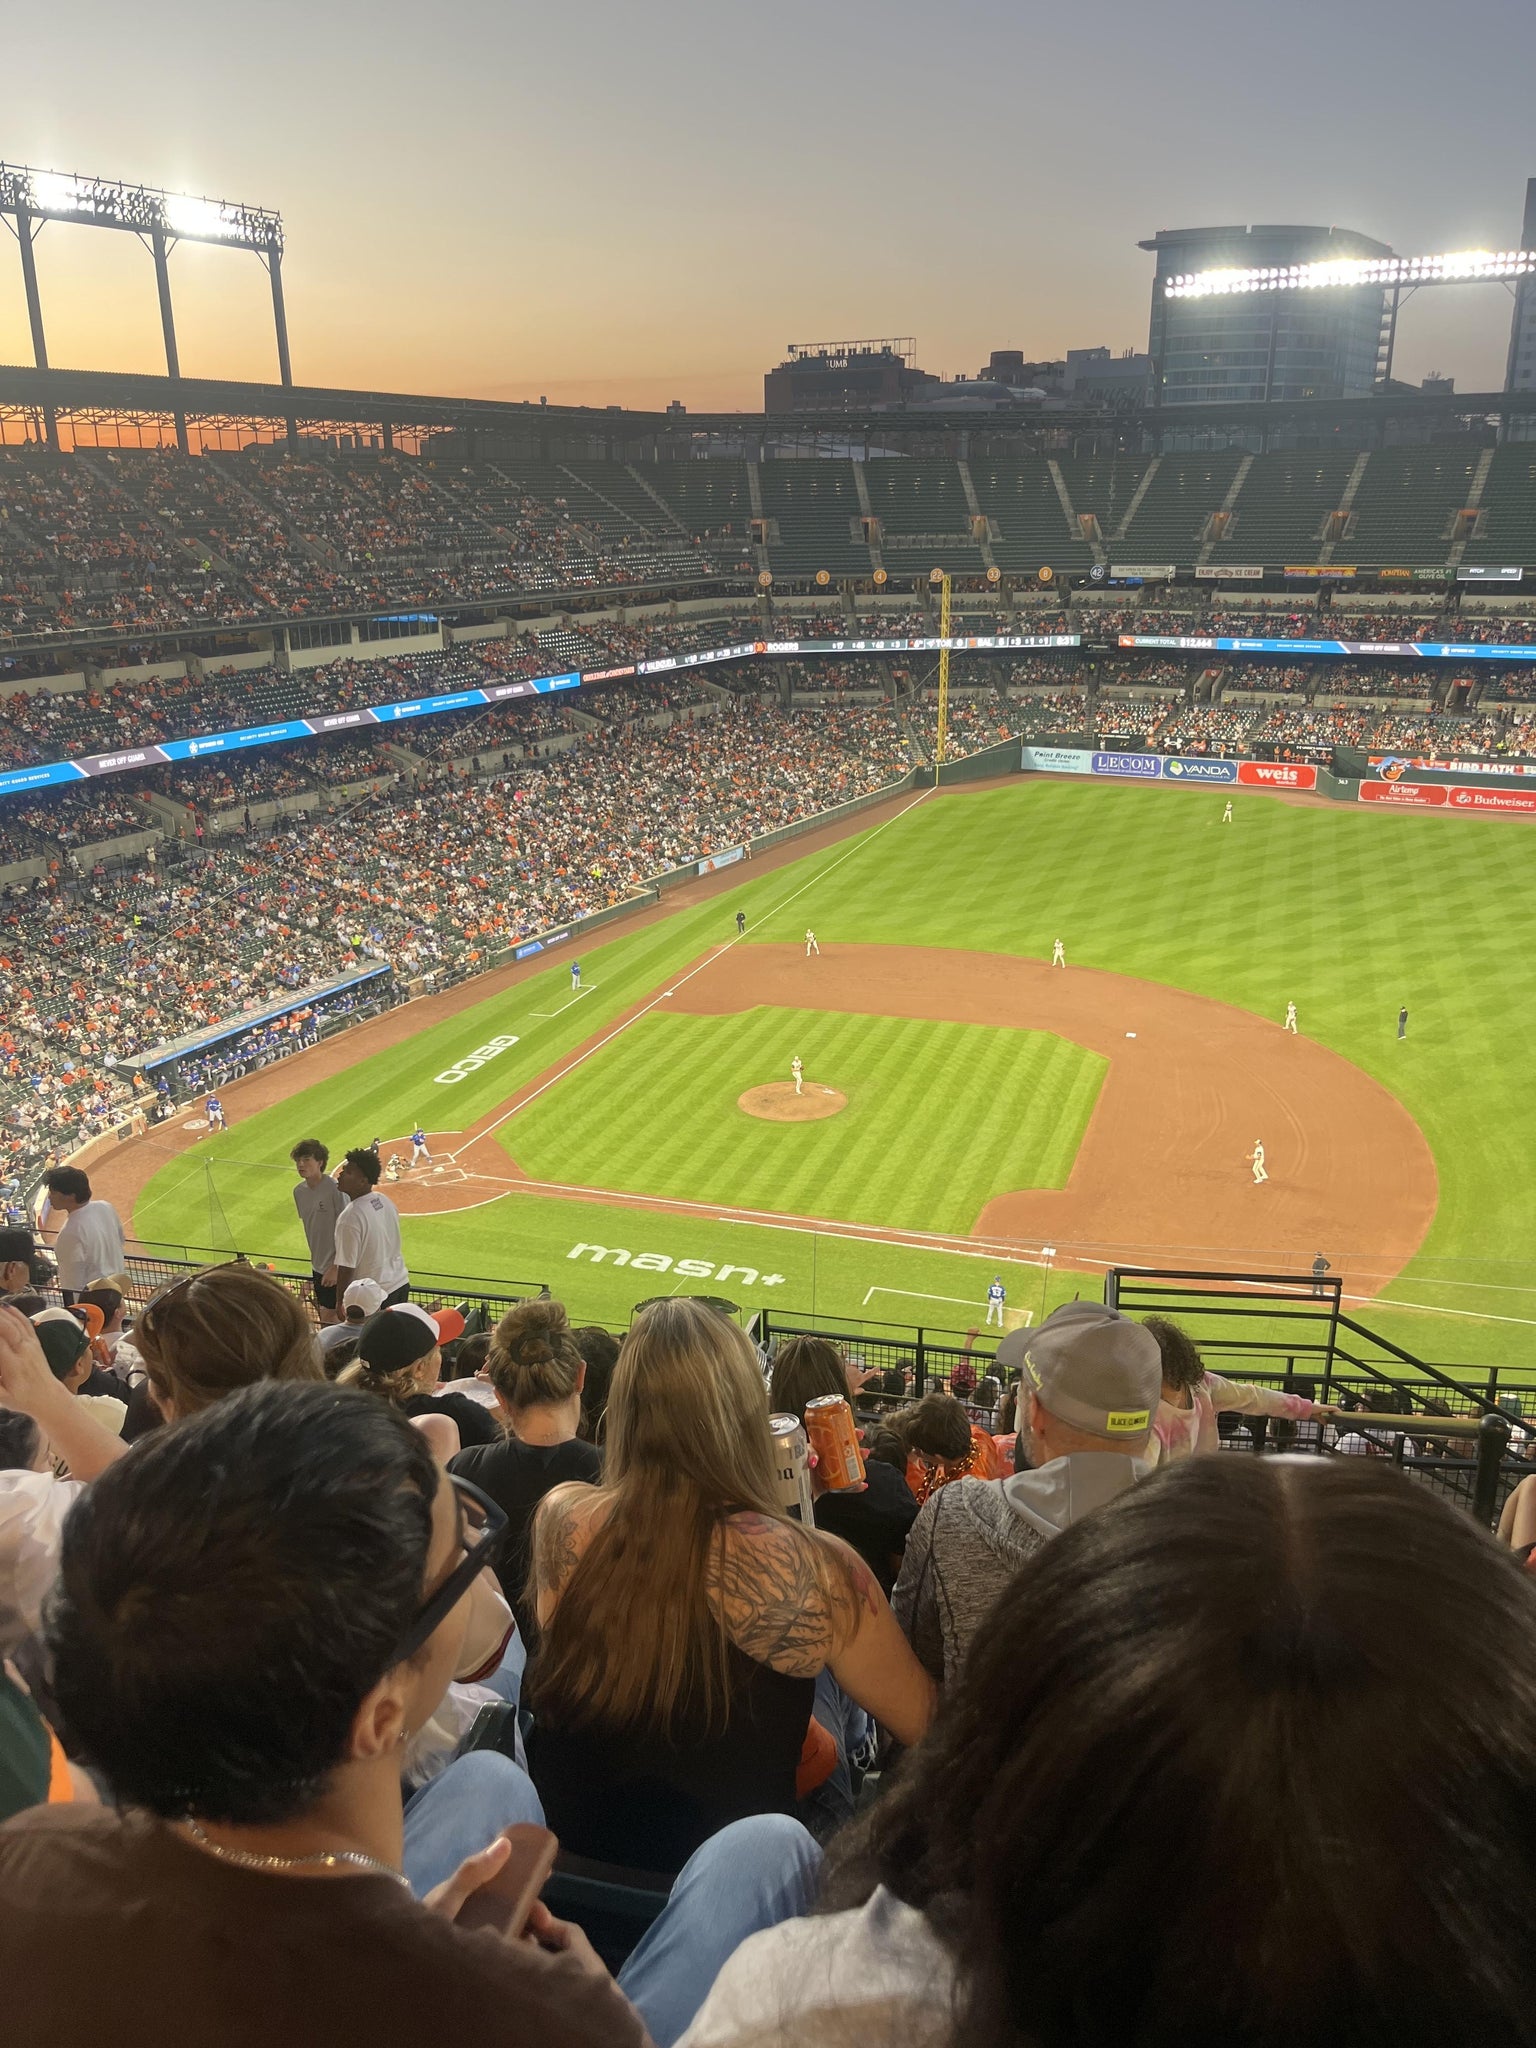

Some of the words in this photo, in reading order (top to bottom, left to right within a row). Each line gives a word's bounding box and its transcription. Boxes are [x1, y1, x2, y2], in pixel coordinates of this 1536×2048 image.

[932, 571, 942, 579] 22
[1092, 568, 1102, 577] 42
[1243, 569, 1261, 577] CREAM
[760, 574, 771, 583] 20
[767, 642, 799, 652] ROGERS
[1135, 638, 1157, 646] CURRENT
[1055, 753, 1081, 761] Breeze
[1097, 756, 1155, 771] LECOM
[1449, 761, 1480, 772] BIRD
[1482, 763, 1515, 774] BATH
[1183, 764, 1231, 776] VANDA
[1255, 767, 1298, 781] weis
[1389, 784, 1420, 795] Airtemp
[433, 1035, 520, 1084] GEICO
